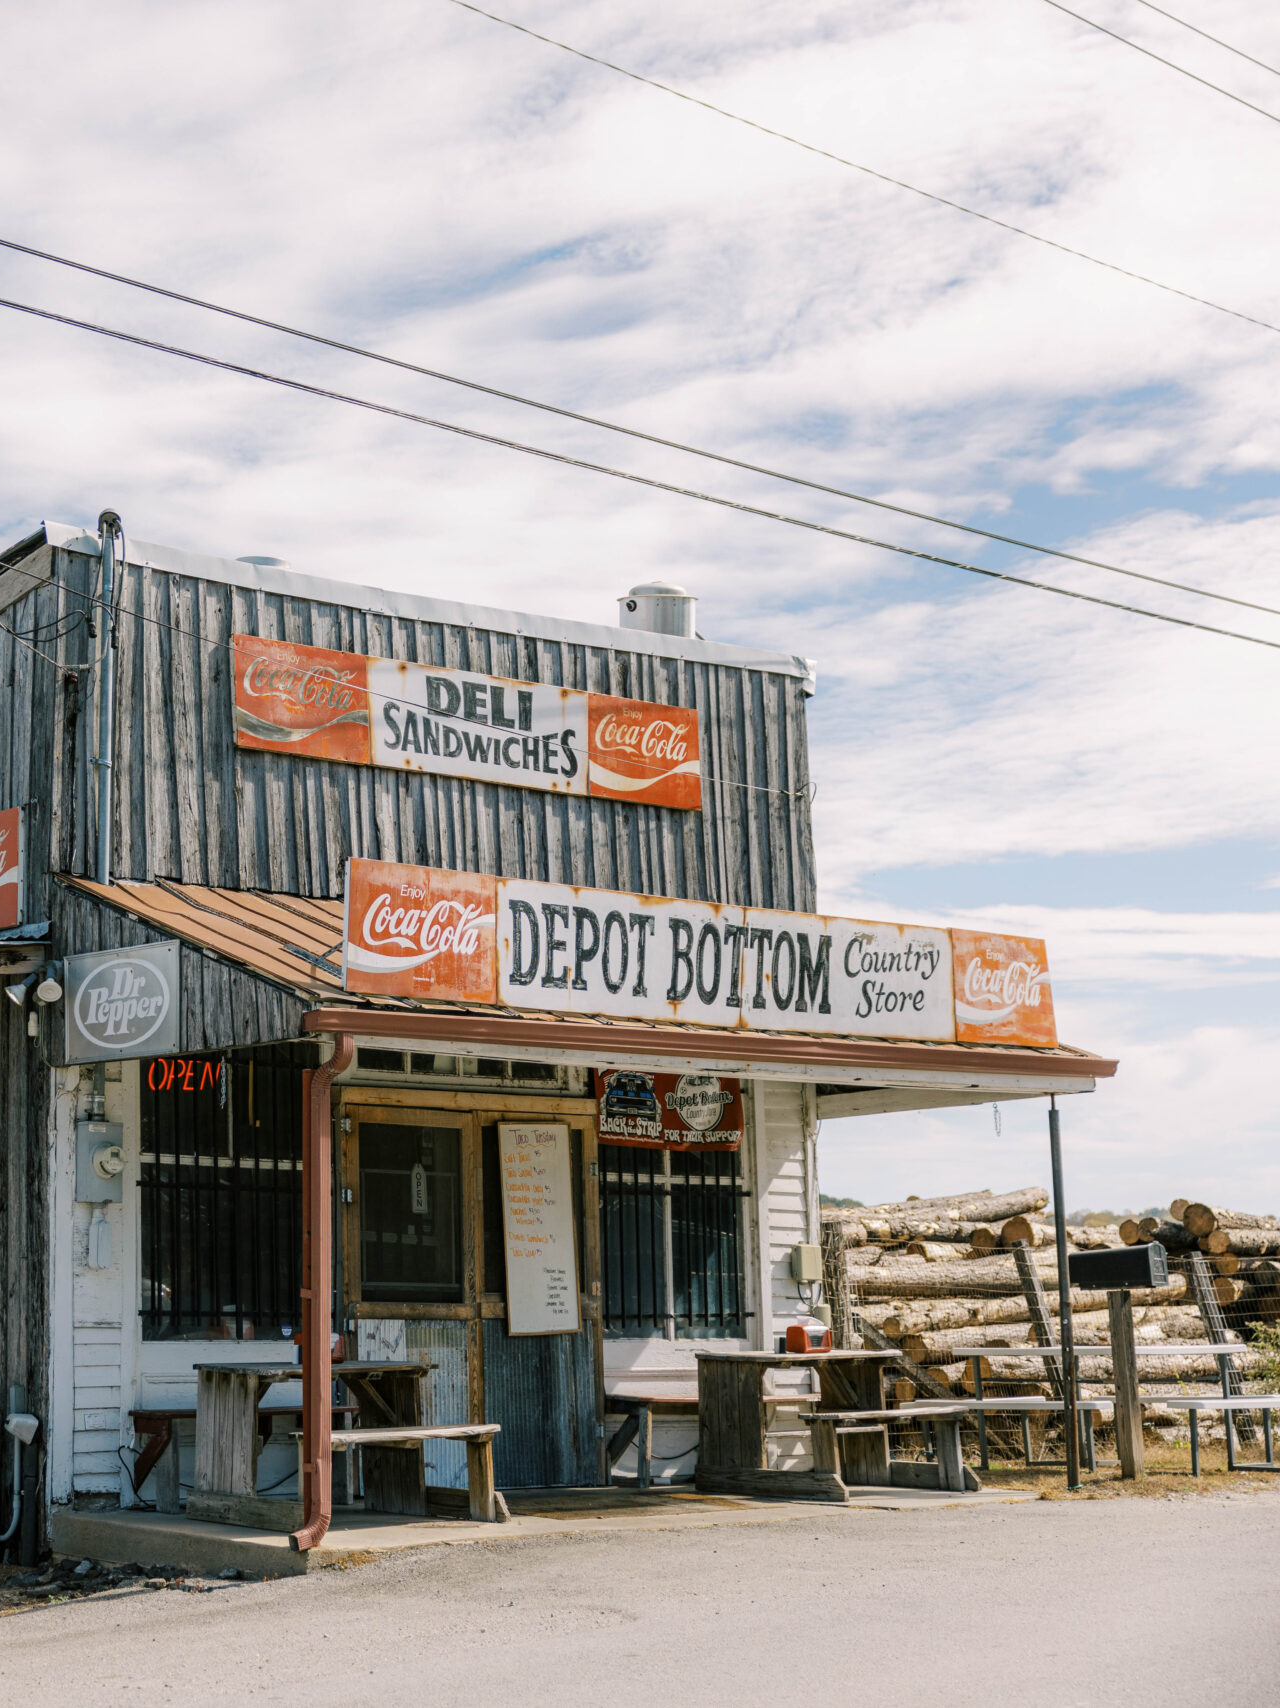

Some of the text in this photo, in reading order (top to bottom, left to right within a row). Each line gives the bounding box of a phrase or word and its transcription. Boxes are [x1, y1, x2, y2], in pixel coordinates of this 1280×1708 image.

[277, 653, 300, 665] Enjoy
[243, 656, 358, 710] Coca-Cola
[426, 674, 533, 731] DELI
[623, 707, 642, 720] Enjoy
[383, 701, 577, 778] SANDWICHES
[595, 713, 690, 761] Coca-Cola
[400, 884, 426, 900] Enjoy
[362, 893, 483, 955] Coca-Cola
[508, 898, 831, 1014] DEPOT BOTTOM
[844, 933, 941, 987] Country
[110, 967, 146, 1000] Dr
[855, 979, 926, 1019] Store
[964, 957, 1042, 1007] Coca-Cola
[84, 987, 164, 1036] Pepper
[148, 1058, 221, 1091] OPEN
[666, 1092, 699, 1111] Depot
[508, 1129, 529, 1145] Taco
[600, 1115, 628, 1137] BACK
[636, 1117, 662, 1138] STRIP
[664, 1129, 681, 1144] FOR
[415, 1172, 423, 1207] OPEN
